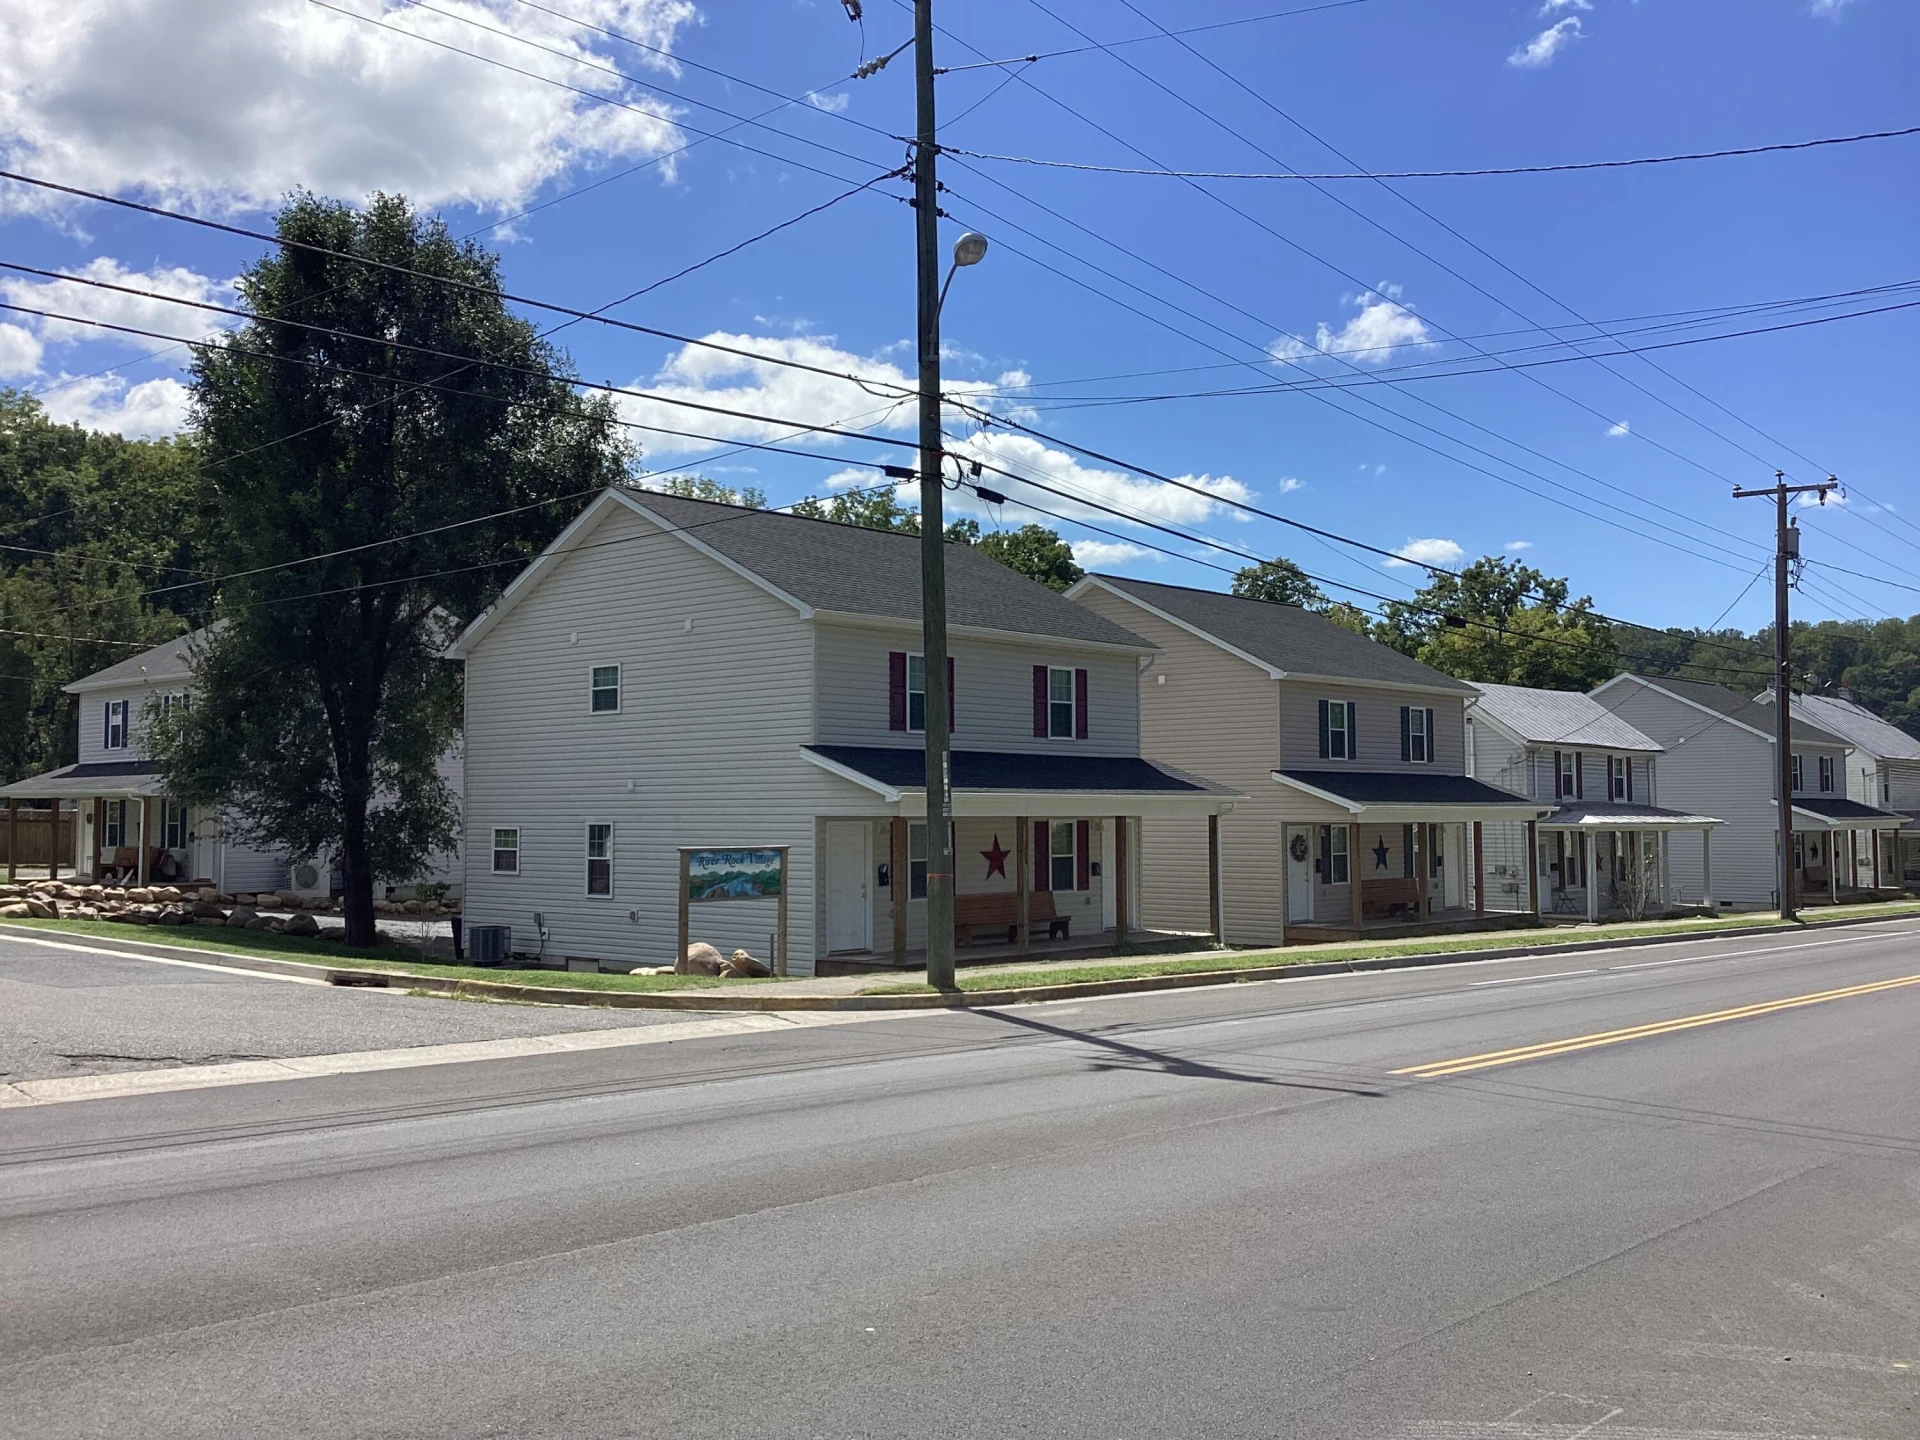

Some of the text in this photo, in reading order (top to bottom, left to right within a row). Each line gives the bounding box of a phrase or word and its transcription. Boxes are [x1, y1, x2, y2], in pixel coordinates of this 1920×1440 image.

[696, 852, 775, 870] River Rock Village
